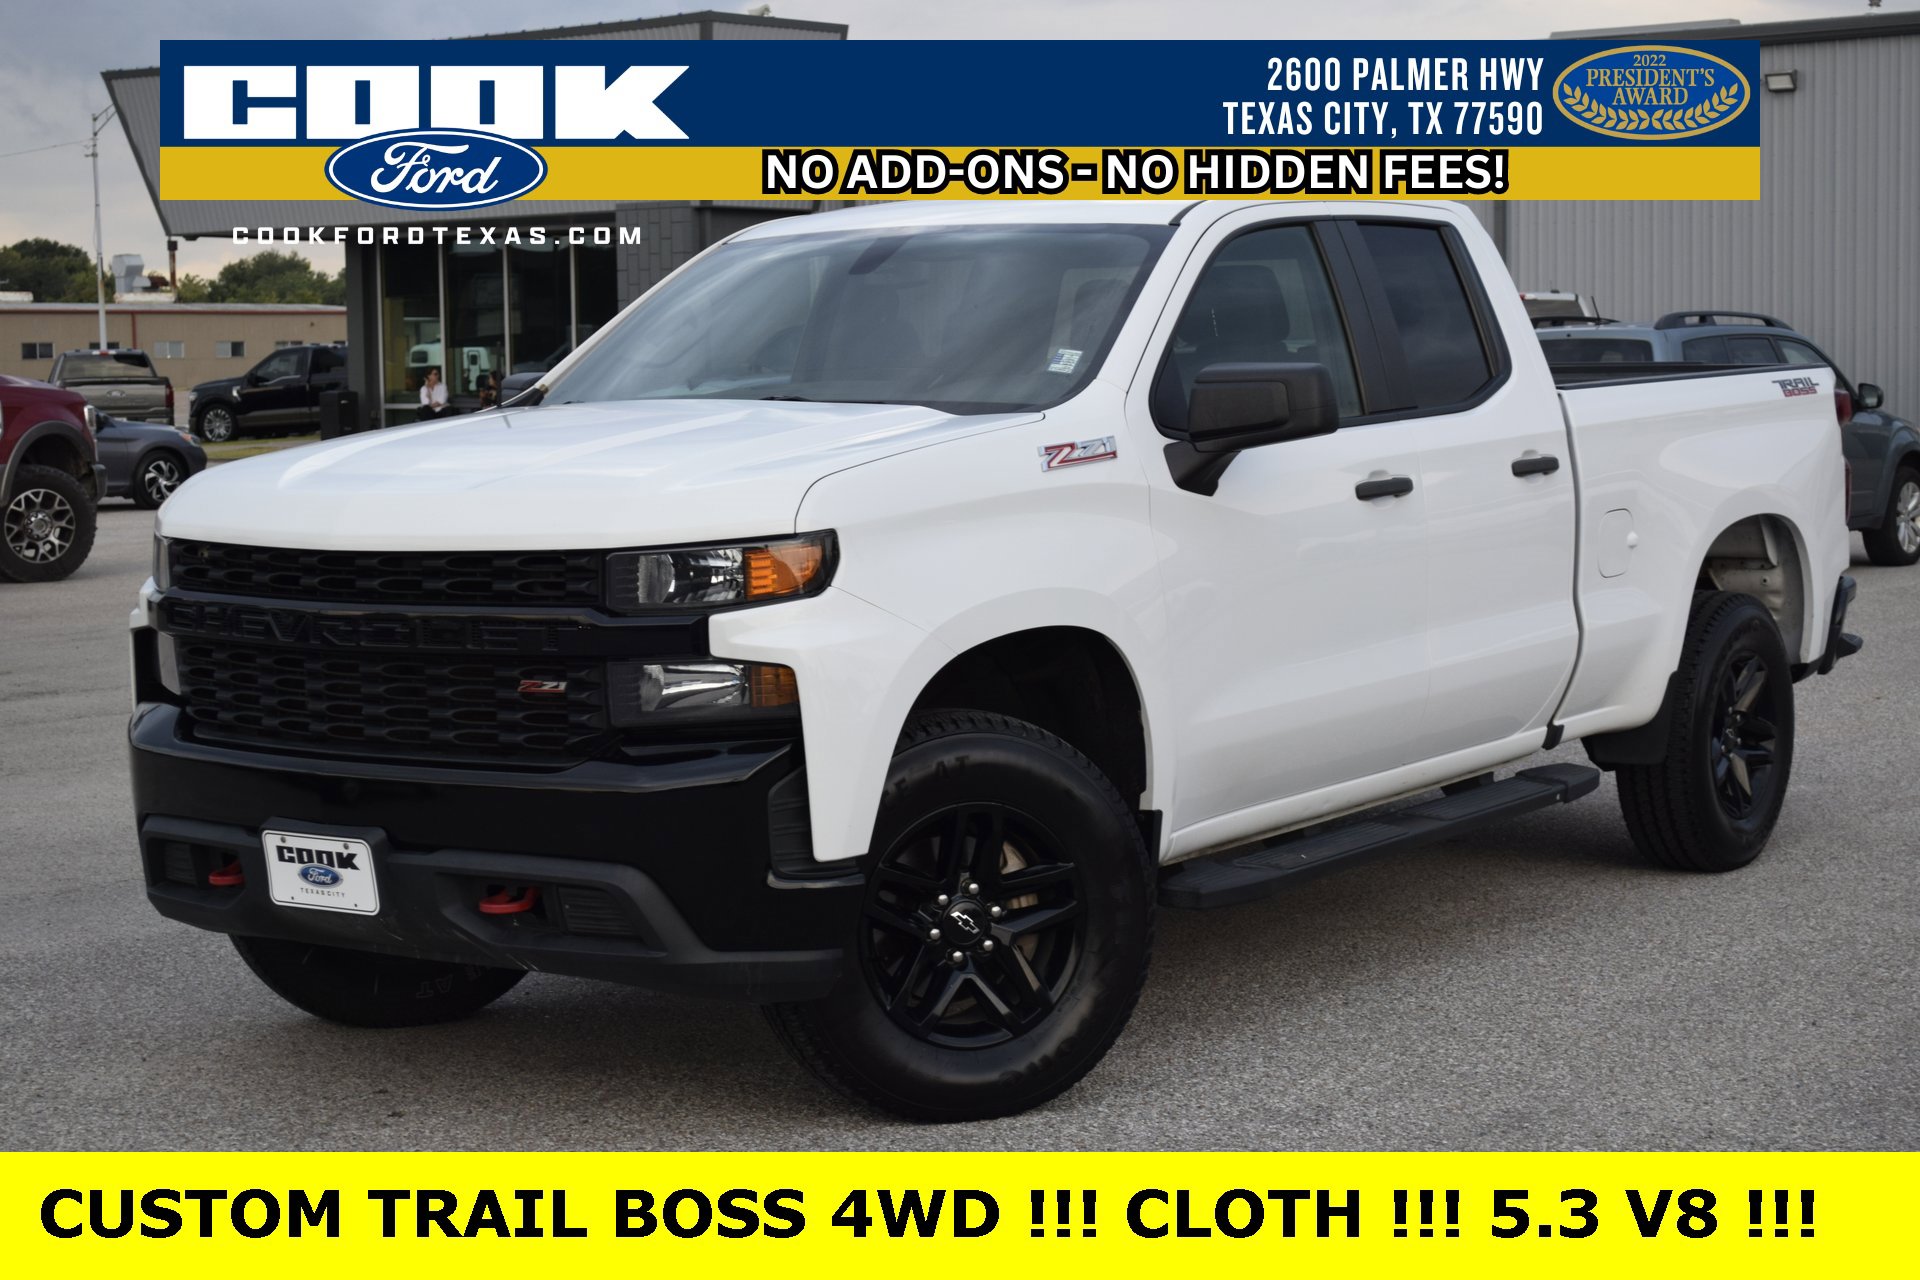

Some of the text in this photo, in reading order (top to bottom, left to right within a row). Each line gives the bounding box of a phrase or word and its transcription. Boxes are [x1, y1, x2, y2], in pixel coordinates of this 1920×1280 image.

[1771, 377, 1820, 389] TRAIL
[1783, 387, 1818, 397] BOSS
[1037, 434, 1118, 473] Z71
[166, 601, 573, 653] CHEVROLET
[517, 679, 567, 693] Z71
[276, 845, 361, 871] COOK
[307, 867, 333, 884] Ford
